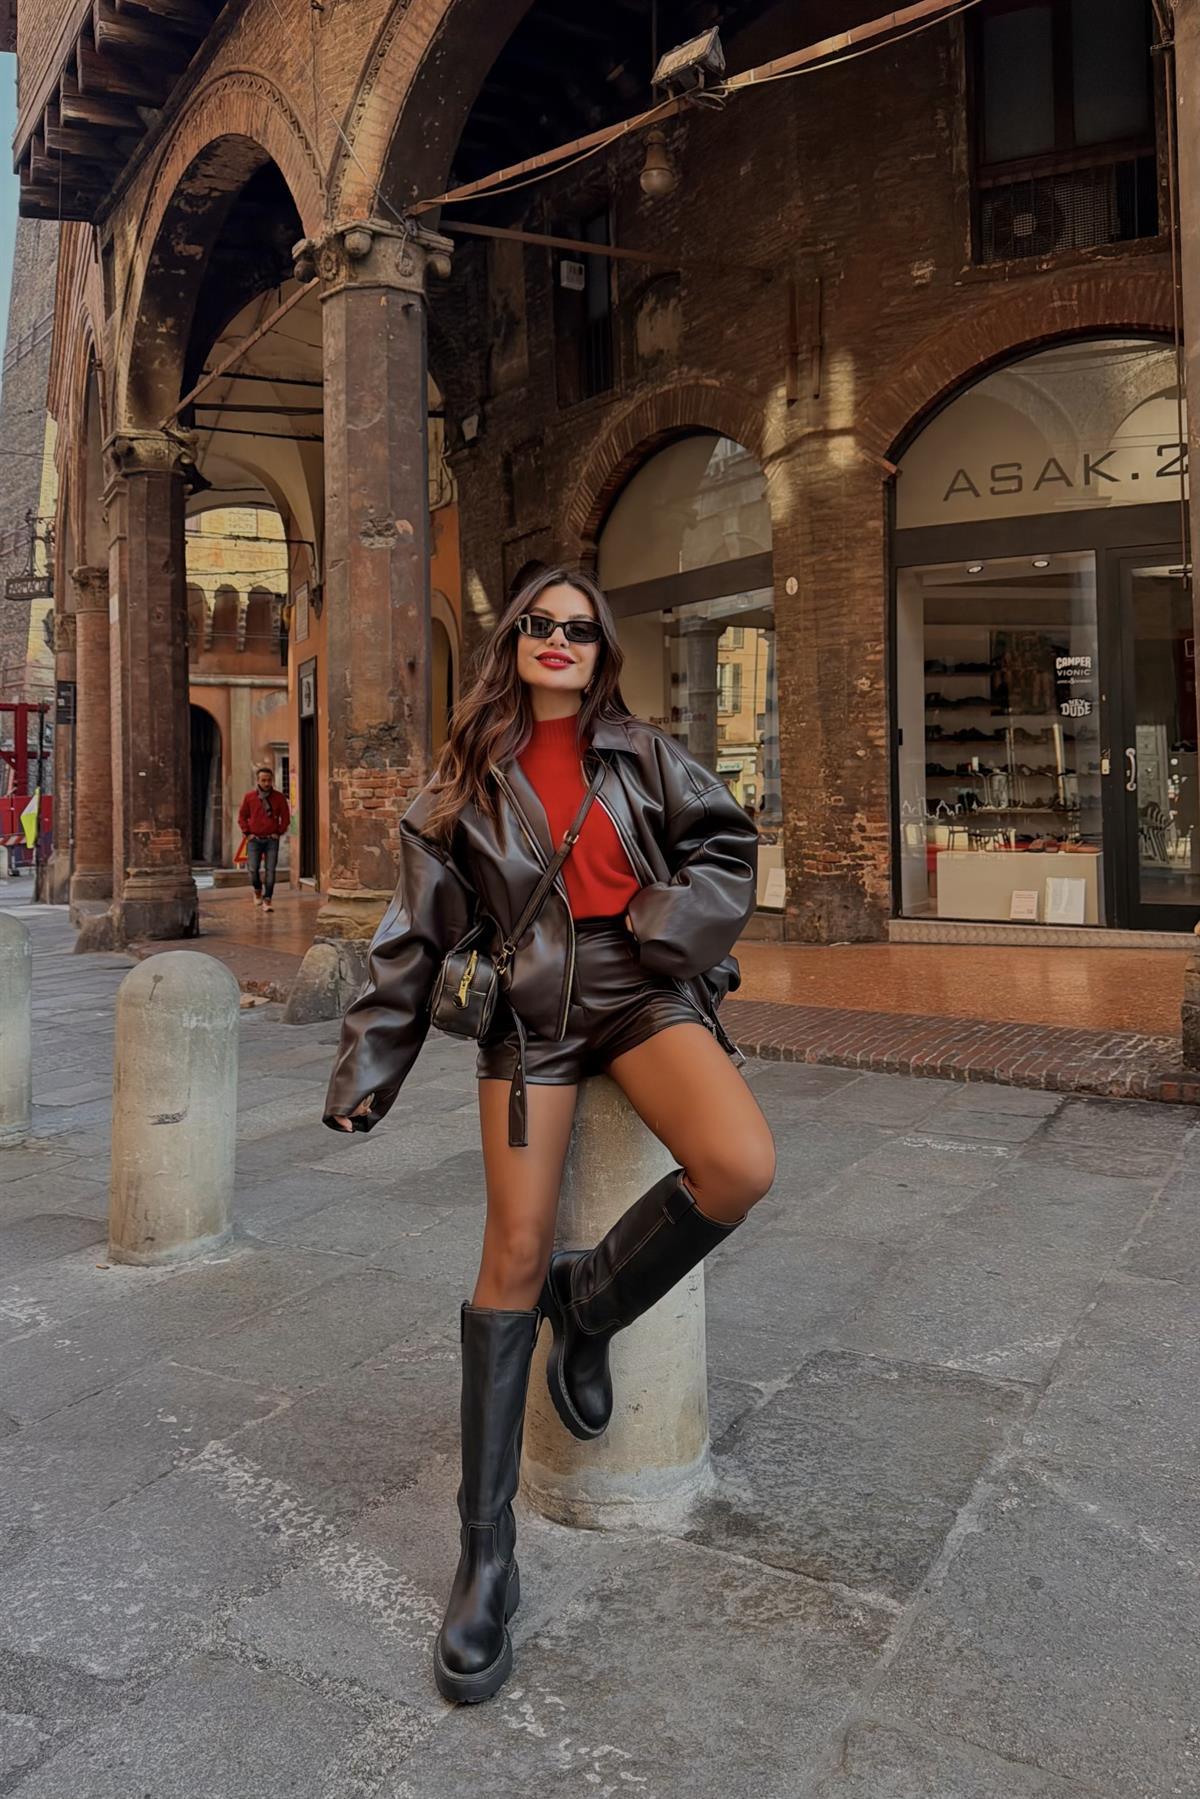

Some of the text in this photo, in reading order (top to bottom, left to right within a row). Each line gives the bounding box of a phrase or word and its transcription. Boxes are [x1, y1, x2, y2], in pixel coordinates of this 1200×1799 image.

[943, 442, 1189, 502] ASAK.2
[1056, 656, 1091, 669] CAMPER
[1056, 669, 1090, 677] VIONIC
[1060, 702, 1091, 716] DUDE
